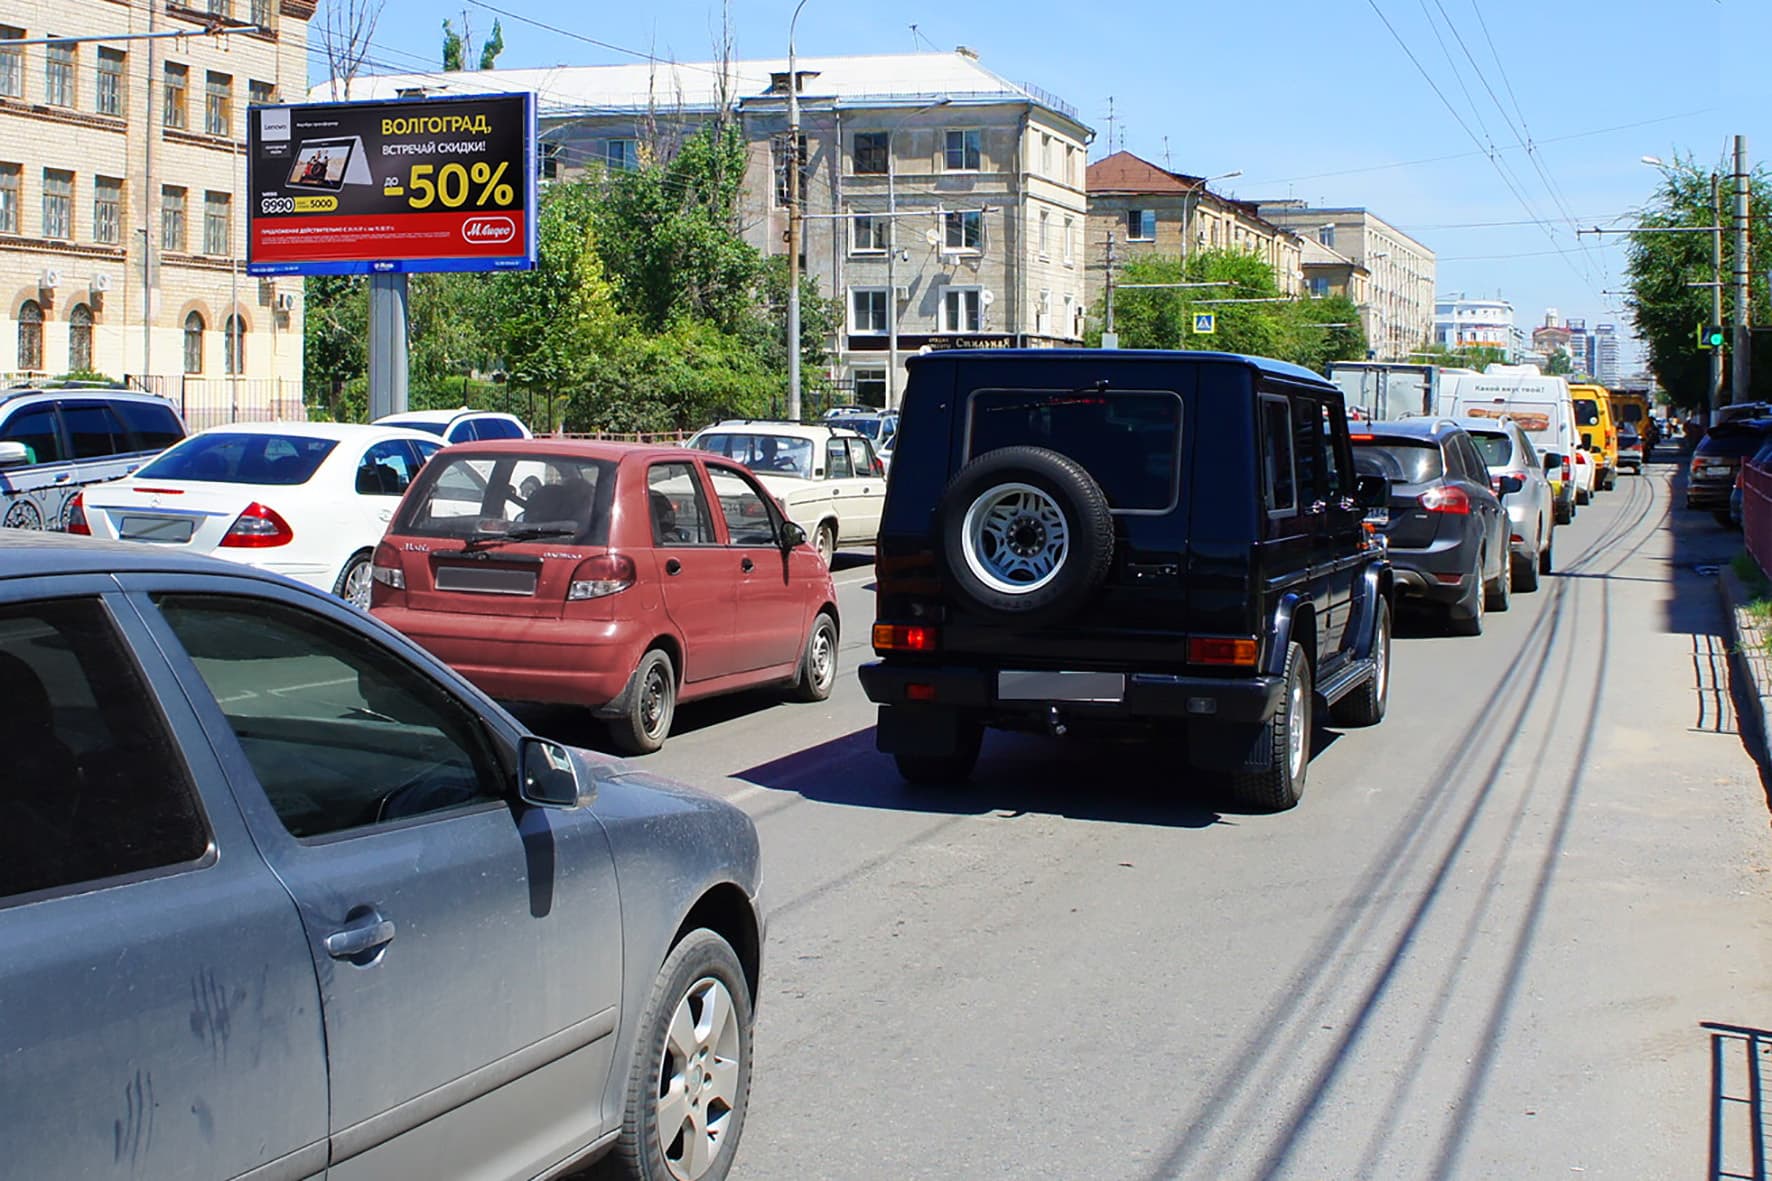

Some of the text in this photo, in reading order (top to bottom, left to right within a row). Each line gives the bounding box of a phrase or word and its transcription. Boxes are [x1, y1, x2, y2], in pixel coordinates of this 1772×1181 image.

[382, 114, 492, 135] ВОЛГОГРАД,
[382, 140, 486, 156] ВСТРЕЧАЙ СКИДКИ!
[262, 198, 295, 213] 9990
[310, 199, 333, 209] 5000
